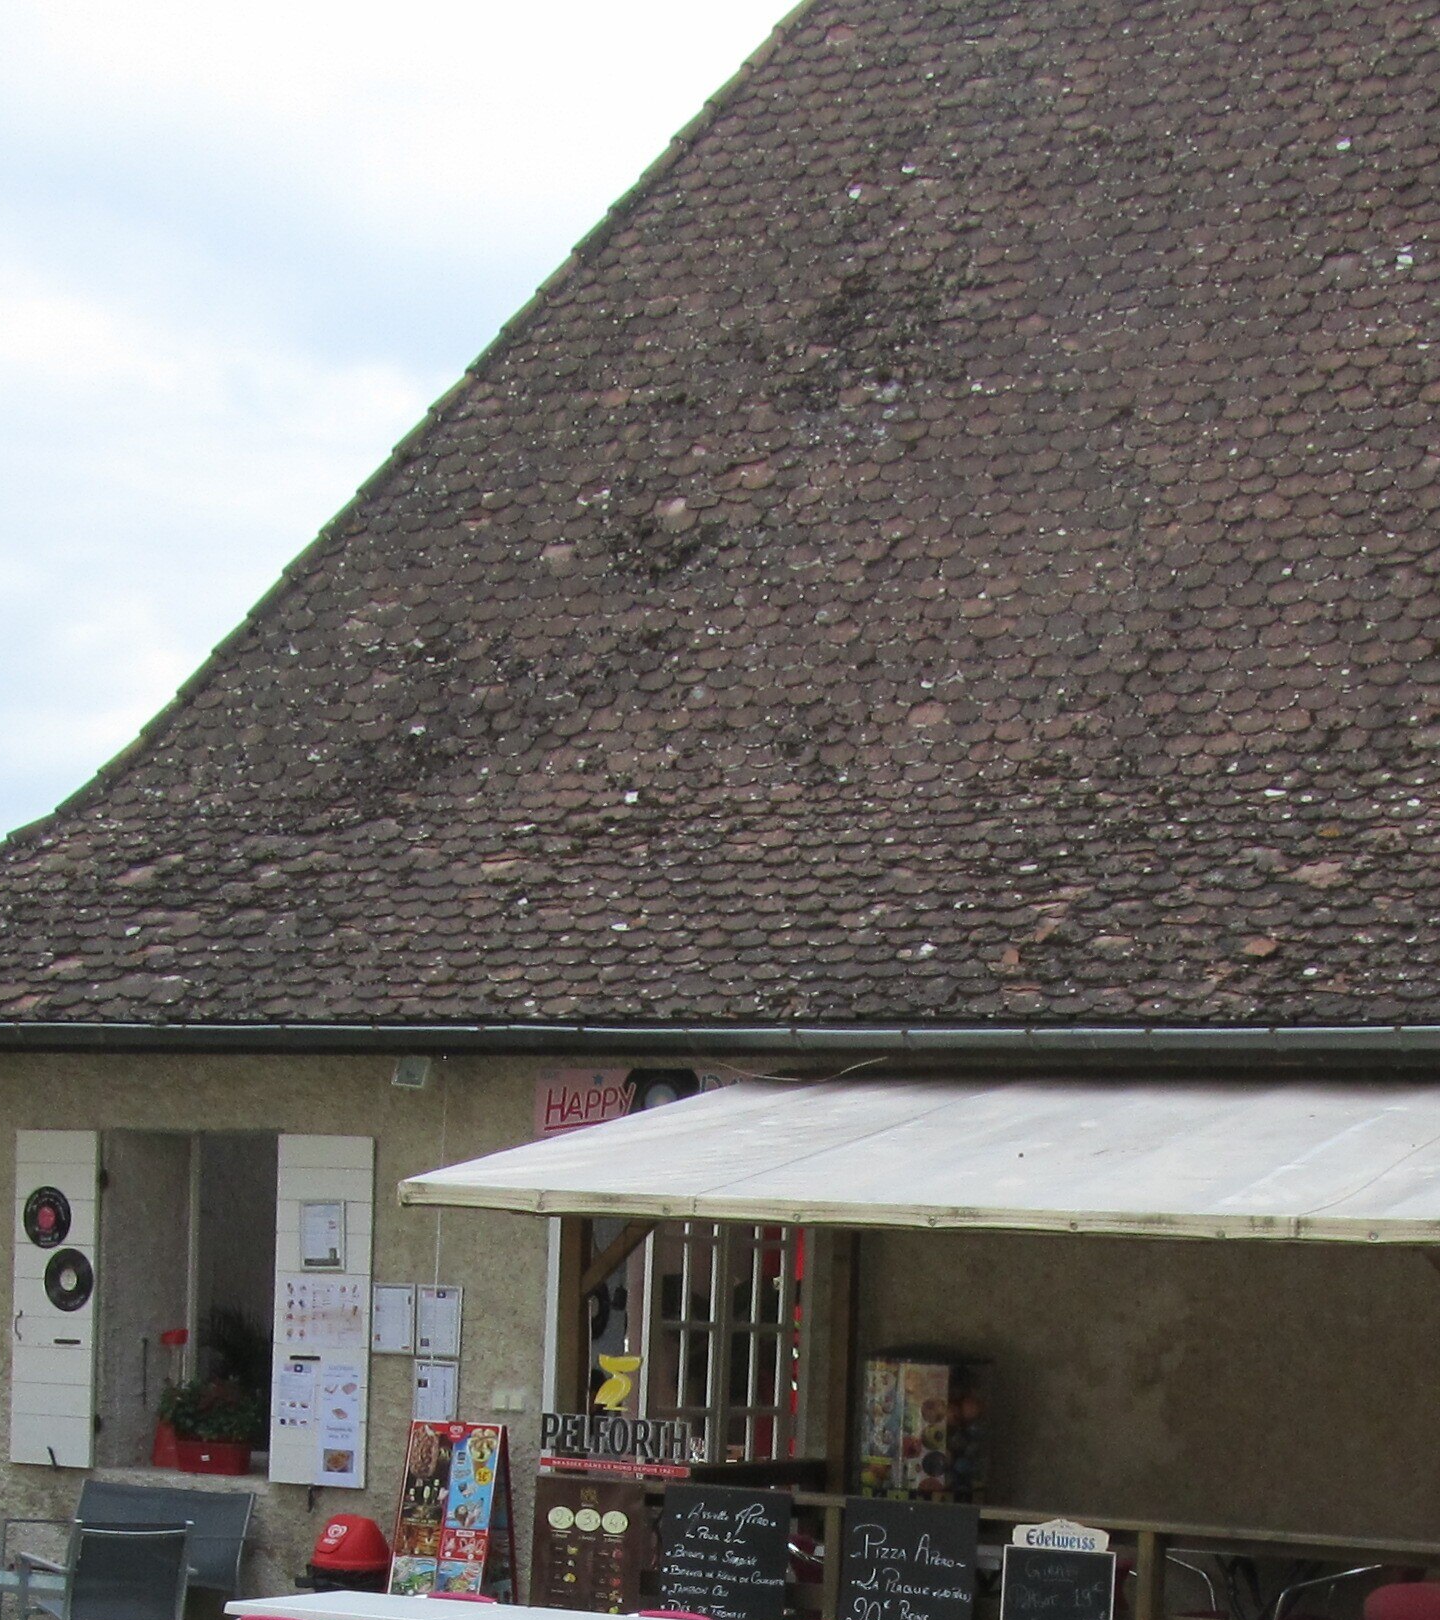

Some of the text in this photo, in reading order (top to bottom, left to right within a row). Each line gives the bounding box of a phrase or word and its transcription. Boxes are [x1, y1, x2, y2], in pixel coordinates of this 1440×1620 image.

[544, 1082, 637, 1127] HAPPY
[541, 1413, 691, 1460] PELFORTH
[1026, 1528, 1095, 1550] Edelweiss
